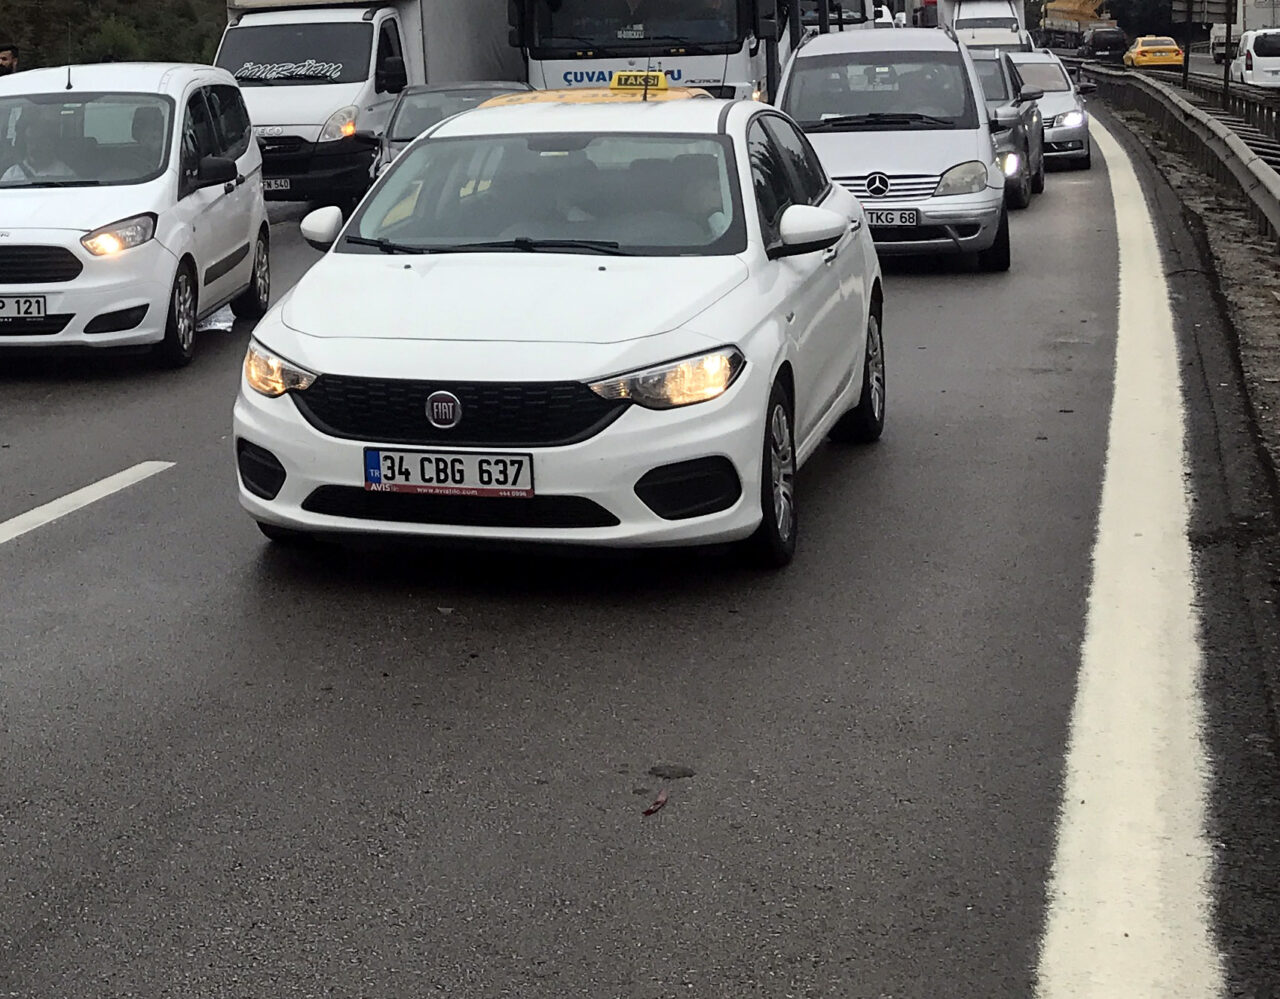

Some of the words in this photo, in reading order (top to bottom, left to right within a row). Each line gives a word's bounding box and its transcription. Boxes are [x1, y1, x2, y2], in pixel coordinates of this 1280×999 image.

[252, 127, 283, 136] VECO
[275, 180, 289, 188] 540
[867, 212, 894, 224] TKG
[900, 212, 915, 224] 68
[15, 299, 41, 315] 121
[433, 402, 454, 420] FIAT
[370, 469, 380, 477] TR
[382, 455, 411, 482] 34
[420, 457, 465, 485] CBG
[478, 458, 524, 486] 637
[370, 483, 391, 492] AVIS
